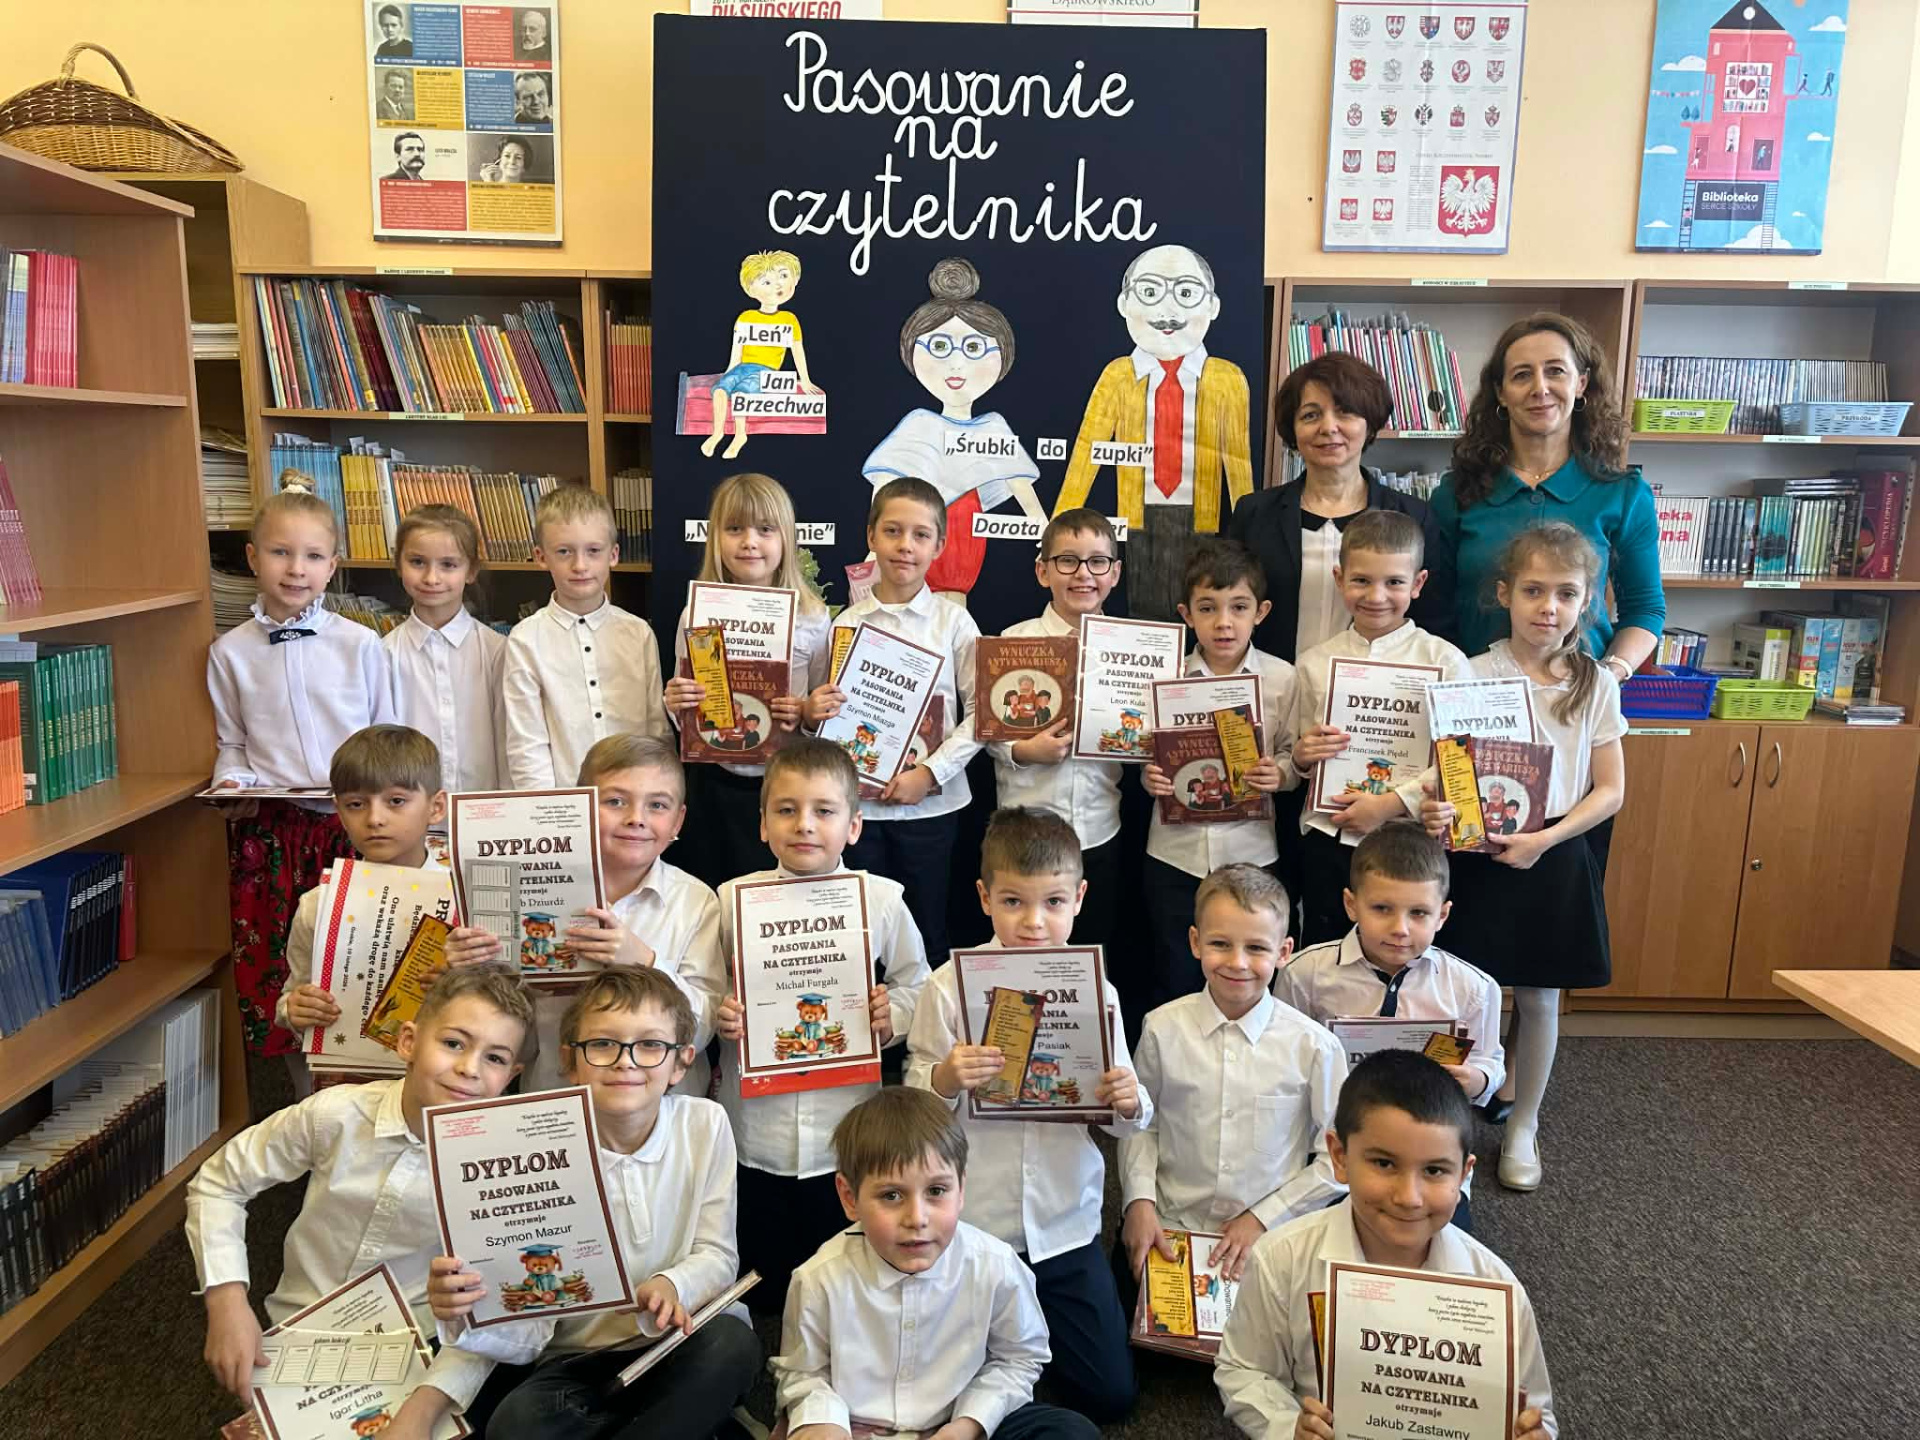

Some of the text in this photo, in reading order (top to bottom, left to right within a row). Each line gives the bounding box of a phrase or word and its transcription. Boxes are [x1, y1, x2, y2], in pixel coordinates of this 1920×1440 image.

[784, 31, 1135, 119] Pasowanie
[894, 115, 998, 161] na
[1701, 202, 1727, 210] SERCE
[1702, 191, 1759, 203] Biblioteka
[768, 153, 1158, 276] czytelnika
[737, 324, 792, 344] „Leń”
[761, 373, 795, 390] Jan
[732, 396, 824, 414] Brzechwa
[945, 432, 1153, 463] „Śrubki do zupki”
[974, 517, 1040, 536] Dorota
[725, 637, 765, 647] SOWANIA
[999, 646, 1055, 657] WNUCZKA
[1099, 650, 1165, 669] DYPLOM
[859, 659, 919, 693] DYPLOM
[1098, 678, 1110, 686] NA
[1106, 668, 1155, 680] PASOWANIA
[861, 678, 904, 701] PASOWANIA
[850, 686, 906, 714] NA CZYTELNIKA
[1110, 696, 1128, 706] Leon
[1346, 694, 1421, 714] DYPLOM
[846, 704, 872, 720] Szymon
[1354, 714, 1409, 726] PASOWANIA
[1345, 725, 1416, 739] NA CZYTELNIKA
[1452, 715, 1518, 732] DYPLOM
[1348, 745, 1385, 756] Franciszek
[478, 836, 573, 857] DYPLOM
[519, 861, 562, 871] WANIA
[519, 875, 575, 885] TELNIKA
[381, 885, 389, 905] oraz
[390, 896, 400, 914] One
[759, 914, 847, 939] DYPLOM
[368, 941, 380, 966] drogę
[772, 939, 837, 954] PASOWANIA
[763, 952, 847, 970] NA CZYTELNIKA
[367, 967, 374, 979] do
[775, 979, 805, 991] Michał
[1037, 1041, 1071, 1050] Pasiak
[460, 1148, 571, 1183] DYPLOM
[478, 1179, 561, 1201] PASOWANIA
[470, 1195, 577, 1221] NA CZYTELNIKA
[485, 1223, 573, 1248] Szymon Mazur
[1360, 1328, 1483, 1367] DYPLOM
[1374, 1363, 1466, 1388] PASOWANIA
[296, 1396, 317, 1411] NA
[1361, 1381, 1480, 1410] NA CZYTELNIKA
[329, 1403, 353, 1420] Igor
[1395, 1403, 1443, 1418] otrzymuje
[1365, 1414, 1471, 1440] Jakub Zastawny
